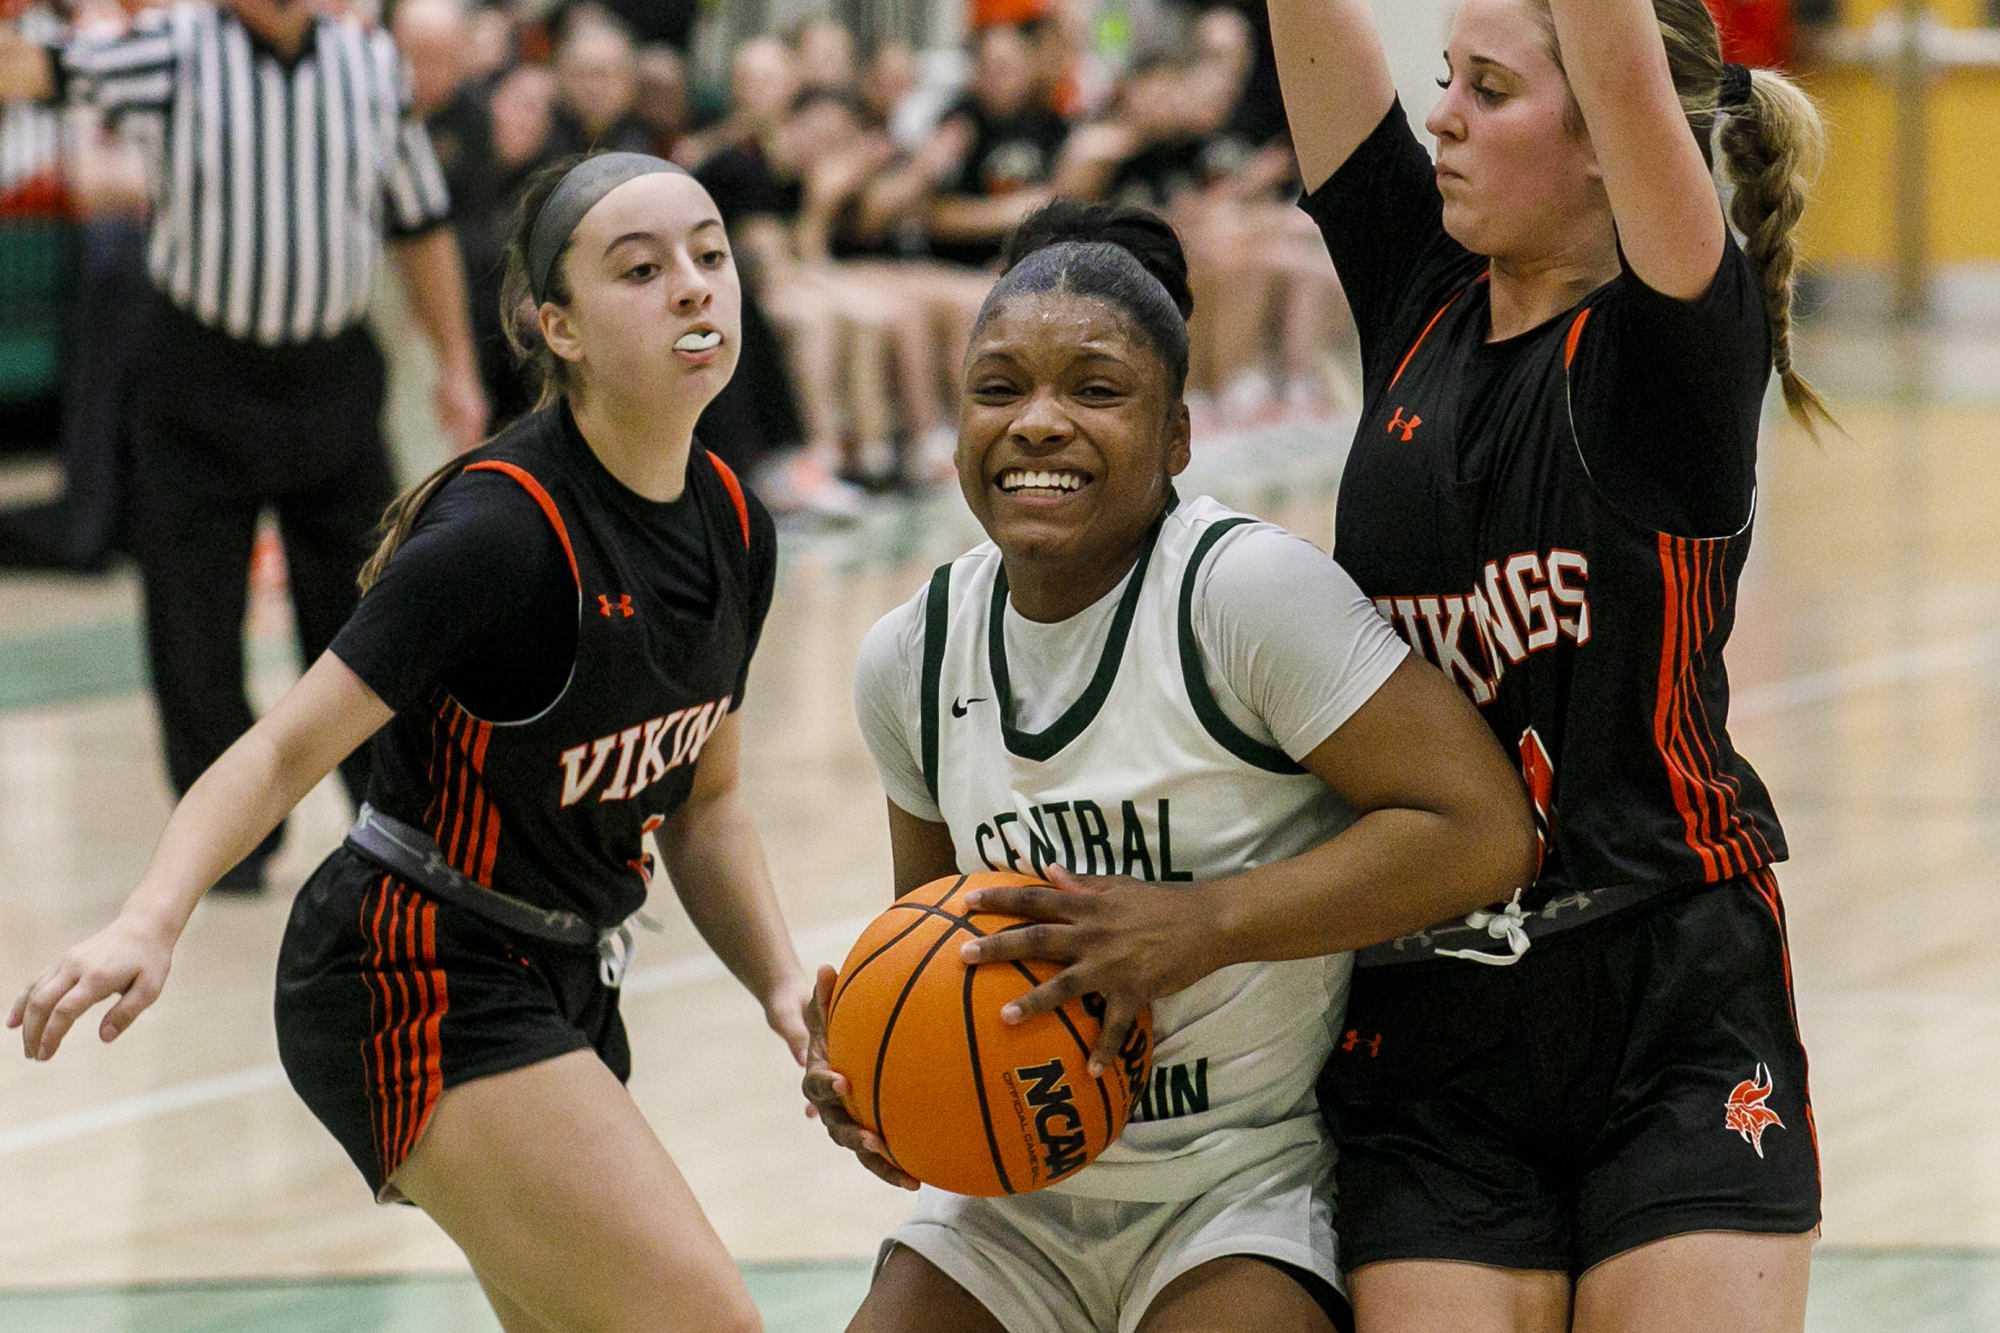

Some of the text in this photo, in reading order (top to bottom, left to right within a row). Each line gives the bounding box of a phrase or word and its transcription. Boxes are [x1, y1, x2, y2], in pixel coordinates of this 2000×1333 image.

[558, 694, 733, 809] VIKIN
[974, 798, 1194, 882] CENTRAL
[1003, 1071, 1028, 1132] OFFICIAL
[1013, 1056, 1088, 1181] NCAA
